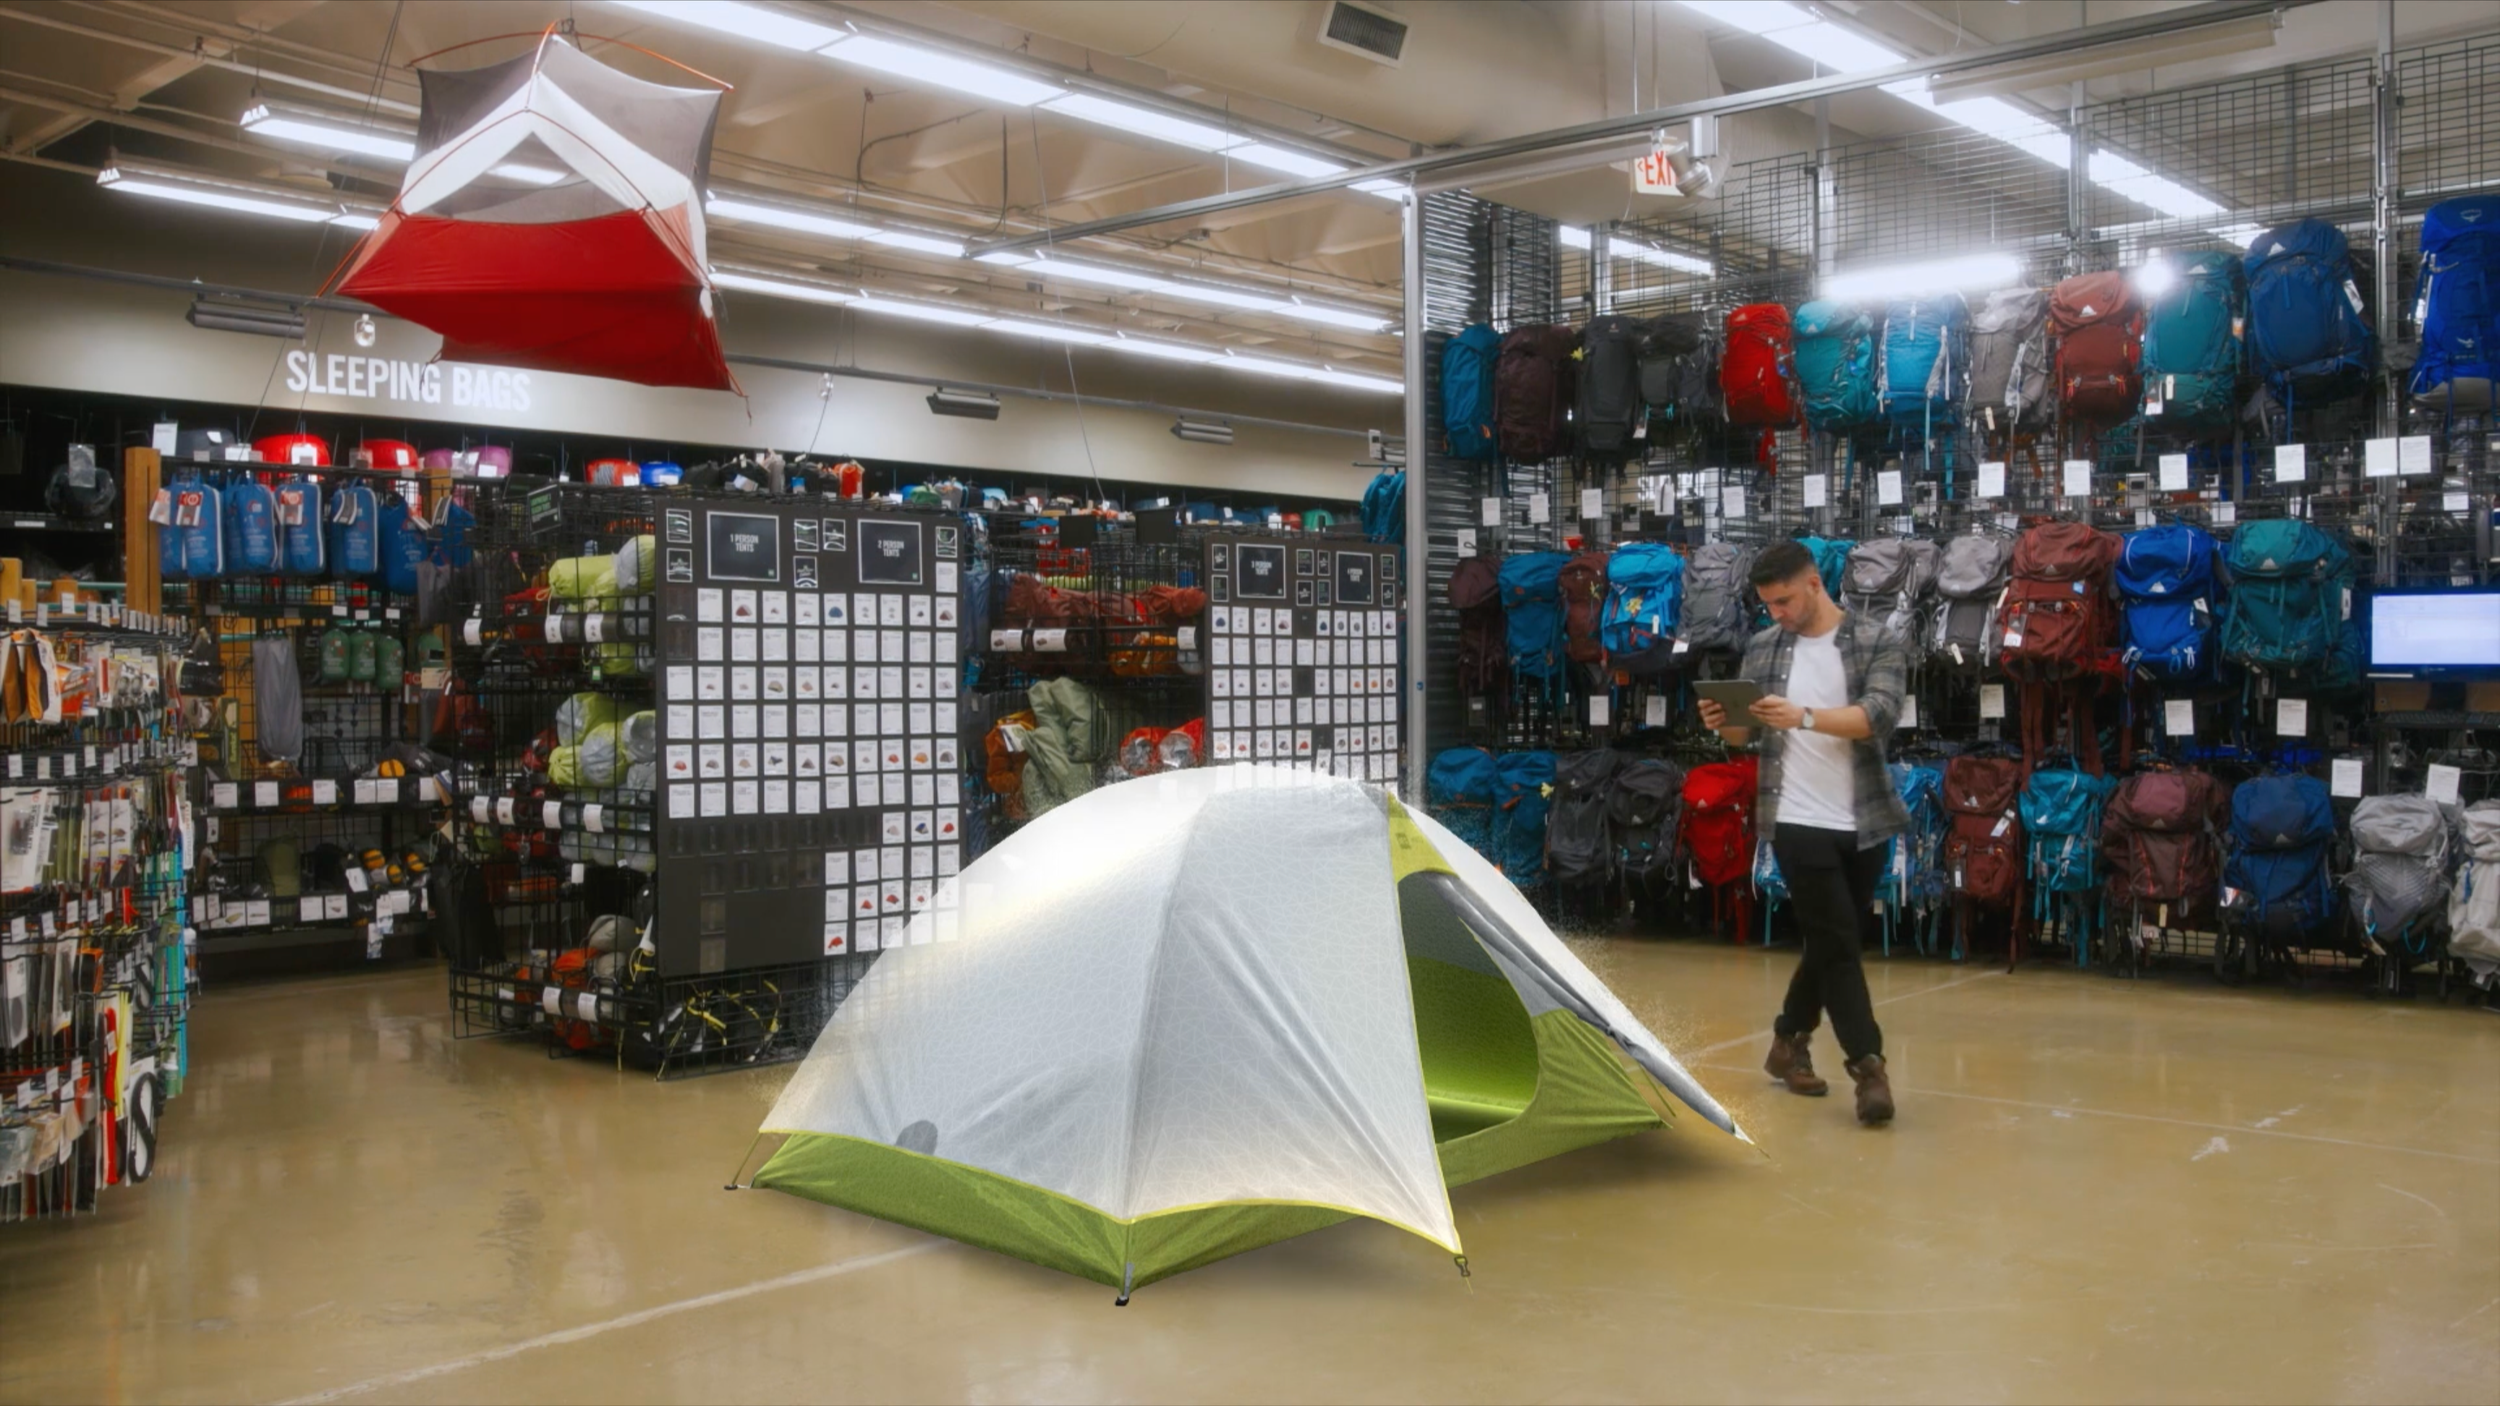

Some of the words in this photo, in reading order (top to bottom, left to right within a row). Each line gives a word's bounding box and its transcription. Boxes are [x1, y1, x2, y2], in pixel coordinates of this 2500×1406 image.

[1644, 150, 1678, 186] EXI
[286, 350, 441, 404] SLEEPING
[453, 366, 532, 412] BAGS
[734, 534, 759, 544] PERSON
[735, 542, 754, 552] TENTS
[883, 540, 905, 550] PERSON
[883, 549, 900, 557] TENTS
